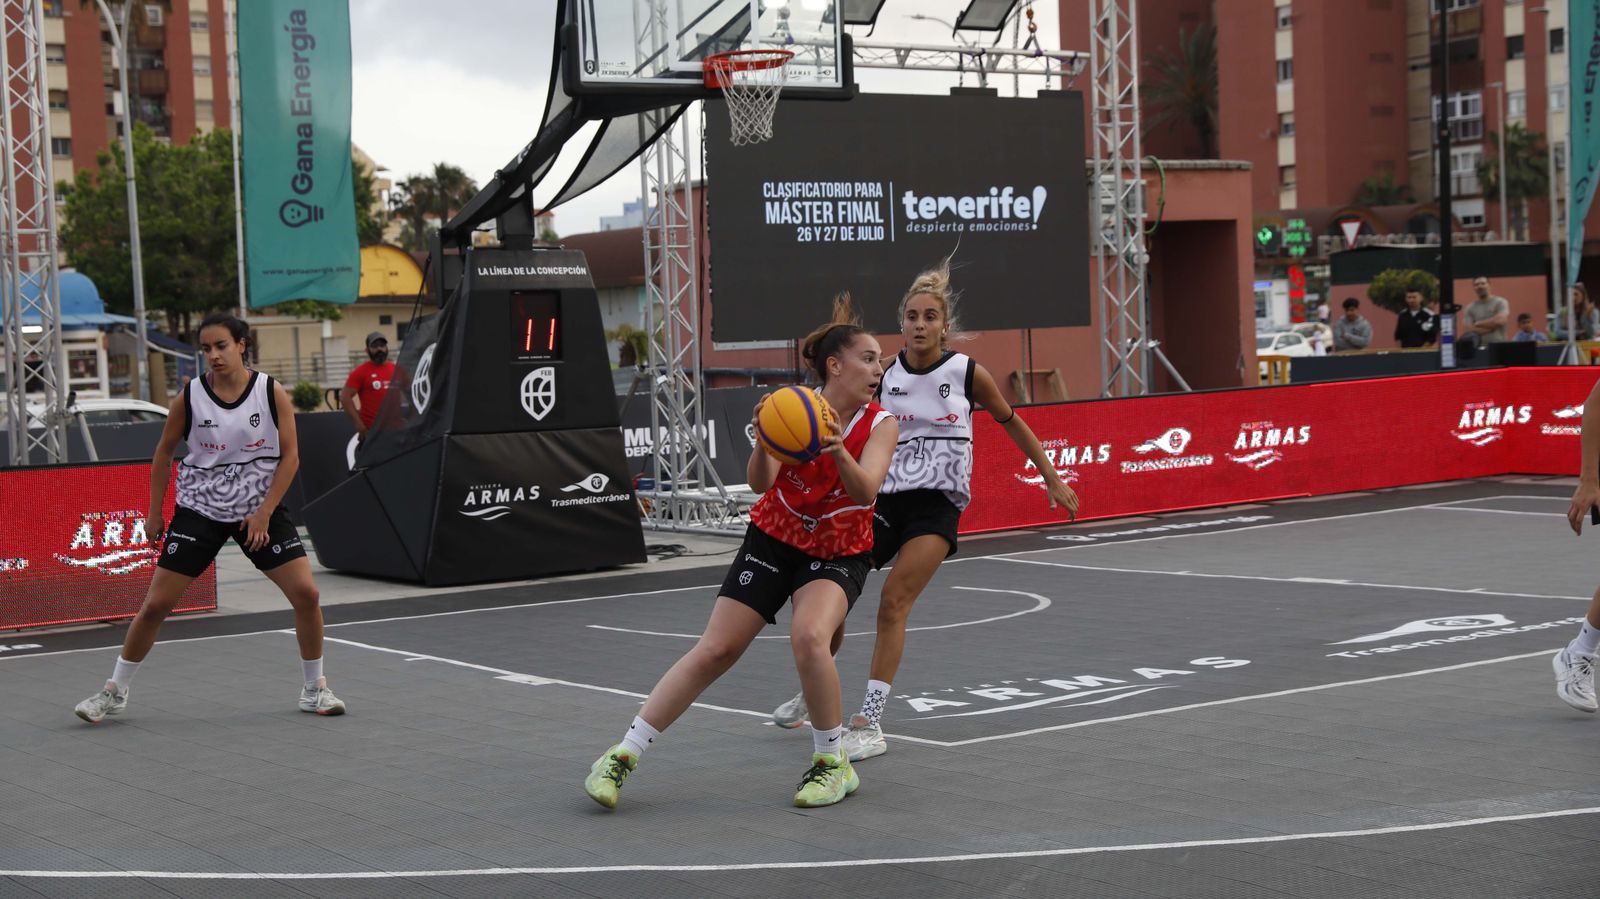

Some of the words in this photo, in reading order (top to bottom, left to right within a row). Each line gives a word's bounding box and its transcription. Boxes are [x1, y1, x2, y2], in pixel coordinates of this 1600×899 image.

[283, 9, 316, 116] Energía
[291, 123, 313, 194] Gana
[763, 182, 852, 198] CLASIFICATORIO
[854, 182, 883, 198] PARA
[765, 197, 833, 224] MÁSTER
[837, 201, 884, 223] FINAL
[797, 226, 812, 242] 26
[814, 226, 822, 241] Y
[823, 226, 838, 241] 27
[840, 226, 855, 241] DE
[856, 225, 885, 241] JULIO
[906, 221, 965, 233] despierta
[969, 220, 1030, 231] emociones
[478, 267, 488, 276] LA
[489, 265, 514, 276] LÍNEA
[514, 267, 525, 275] DE
[526, 267, 537, 275] LA
[537, 265, 587, 275] CONCEPCIÓN
[526, 318, 556, 351] 11
[1457, 405, 1532, 428] ARMAS
[1234, 425, 1311, 449] ARMAS
[463, 485, 541, 506] ARMAS
[905, 656, 1252, 713] ARMAS
